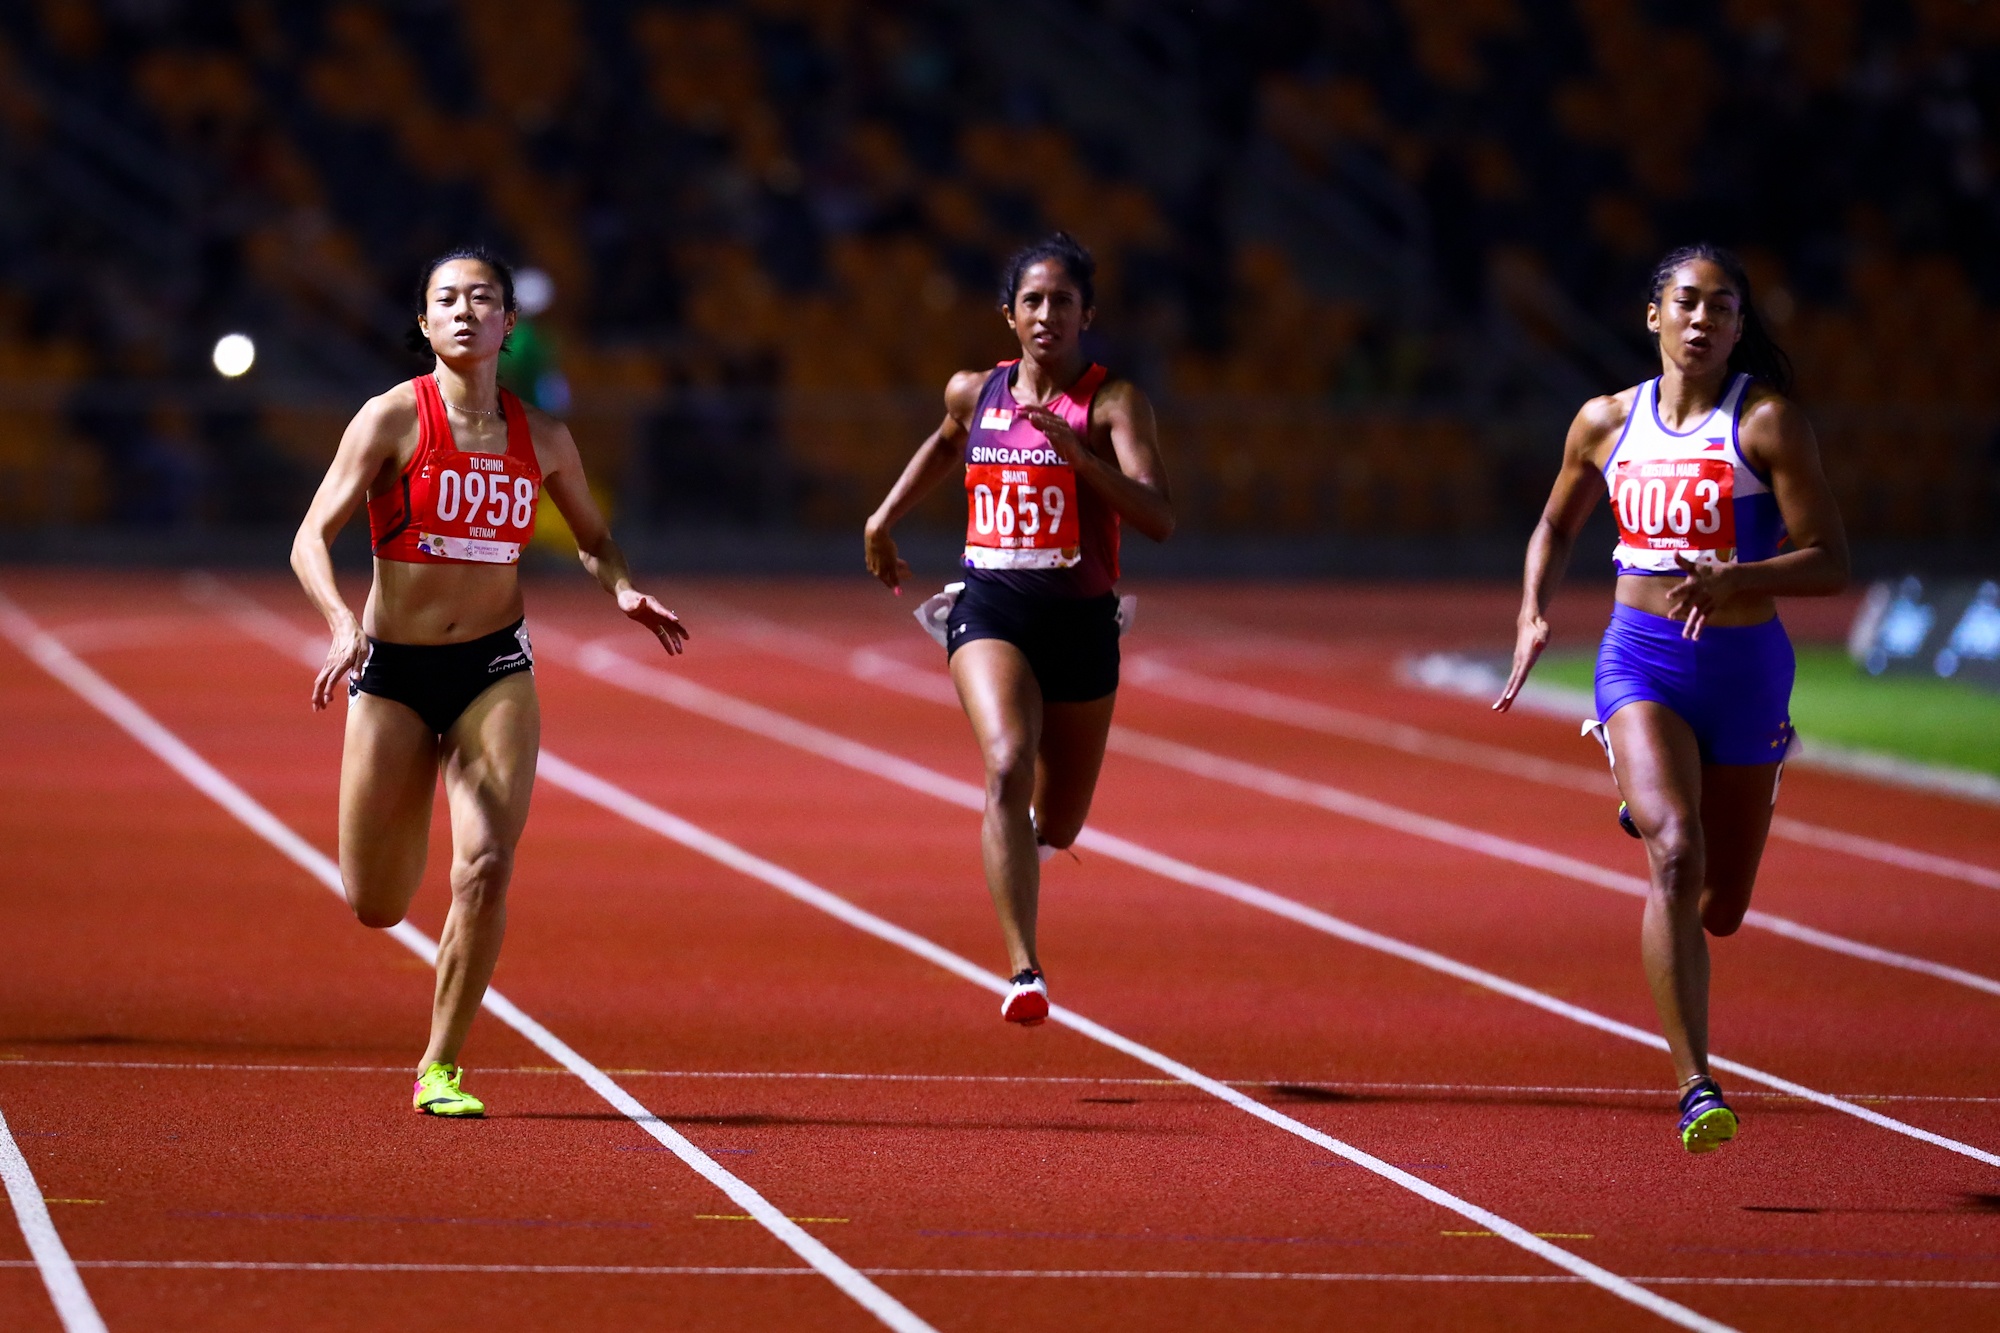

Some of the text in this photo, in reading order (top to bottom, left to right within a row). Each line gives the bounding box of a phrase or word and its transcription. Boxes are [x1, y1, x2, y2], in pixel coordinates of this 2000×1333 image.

[469, 457, 504, 472] TU CHINH
[1676, 463, 1700, 477] MARIE
[1001, 470, 1029, 484] SHANTI
[436, 469, 533, 529] 0958
[974, 483, 1065, 536] 0659
[1617, 478, 1721, 536] 0063
[469, 526, 497, 539] VIETNAM
[488, 658, 526, 673] LI-NING
